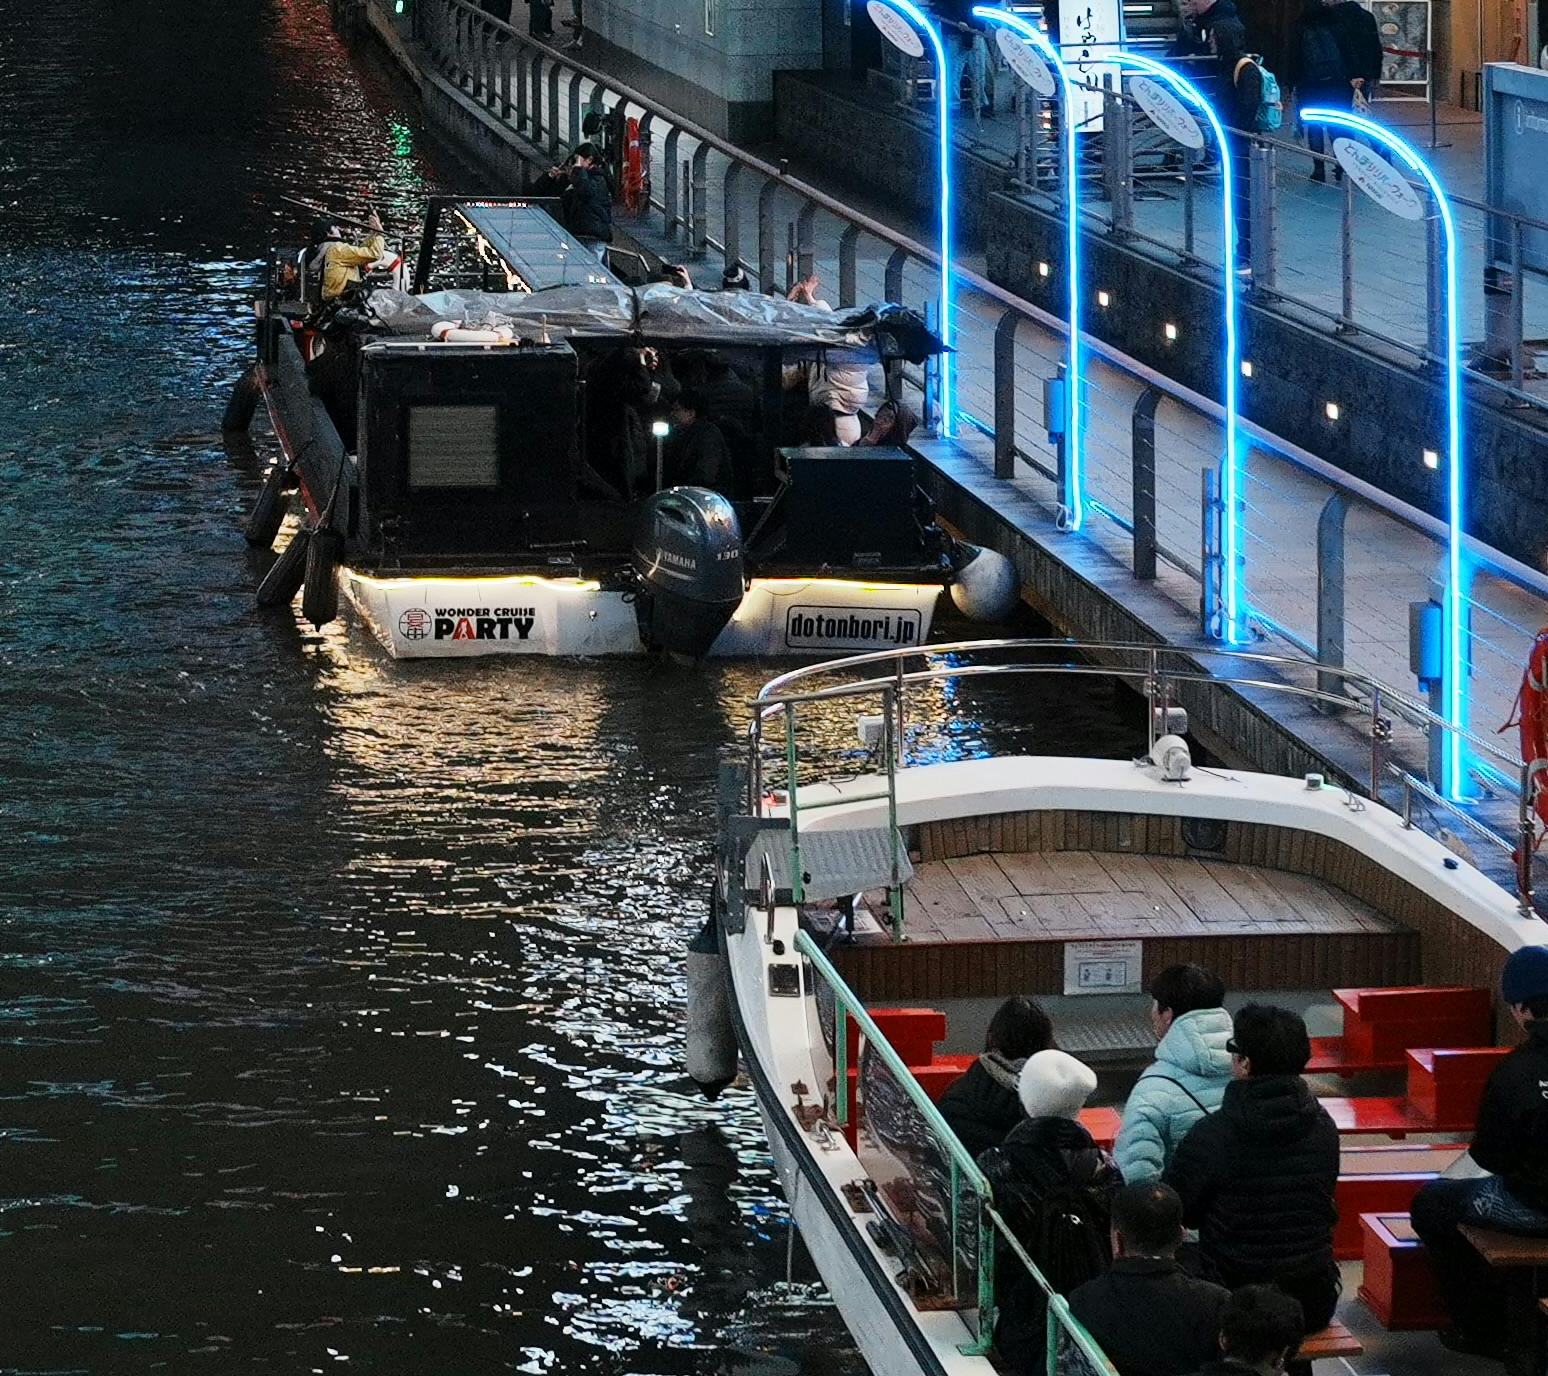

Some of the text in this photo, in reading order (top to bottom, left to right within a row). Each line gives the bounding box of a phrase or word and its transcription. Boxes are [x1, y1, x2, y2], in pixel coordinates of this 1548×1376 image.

[663, 552, 696, 570] YAMAHA
[434, 607, 536, 617] WONDER CRUISE
[434, 616, 535, 641] PARTY
[790, 611, 915, 646] dotonbori.jp
